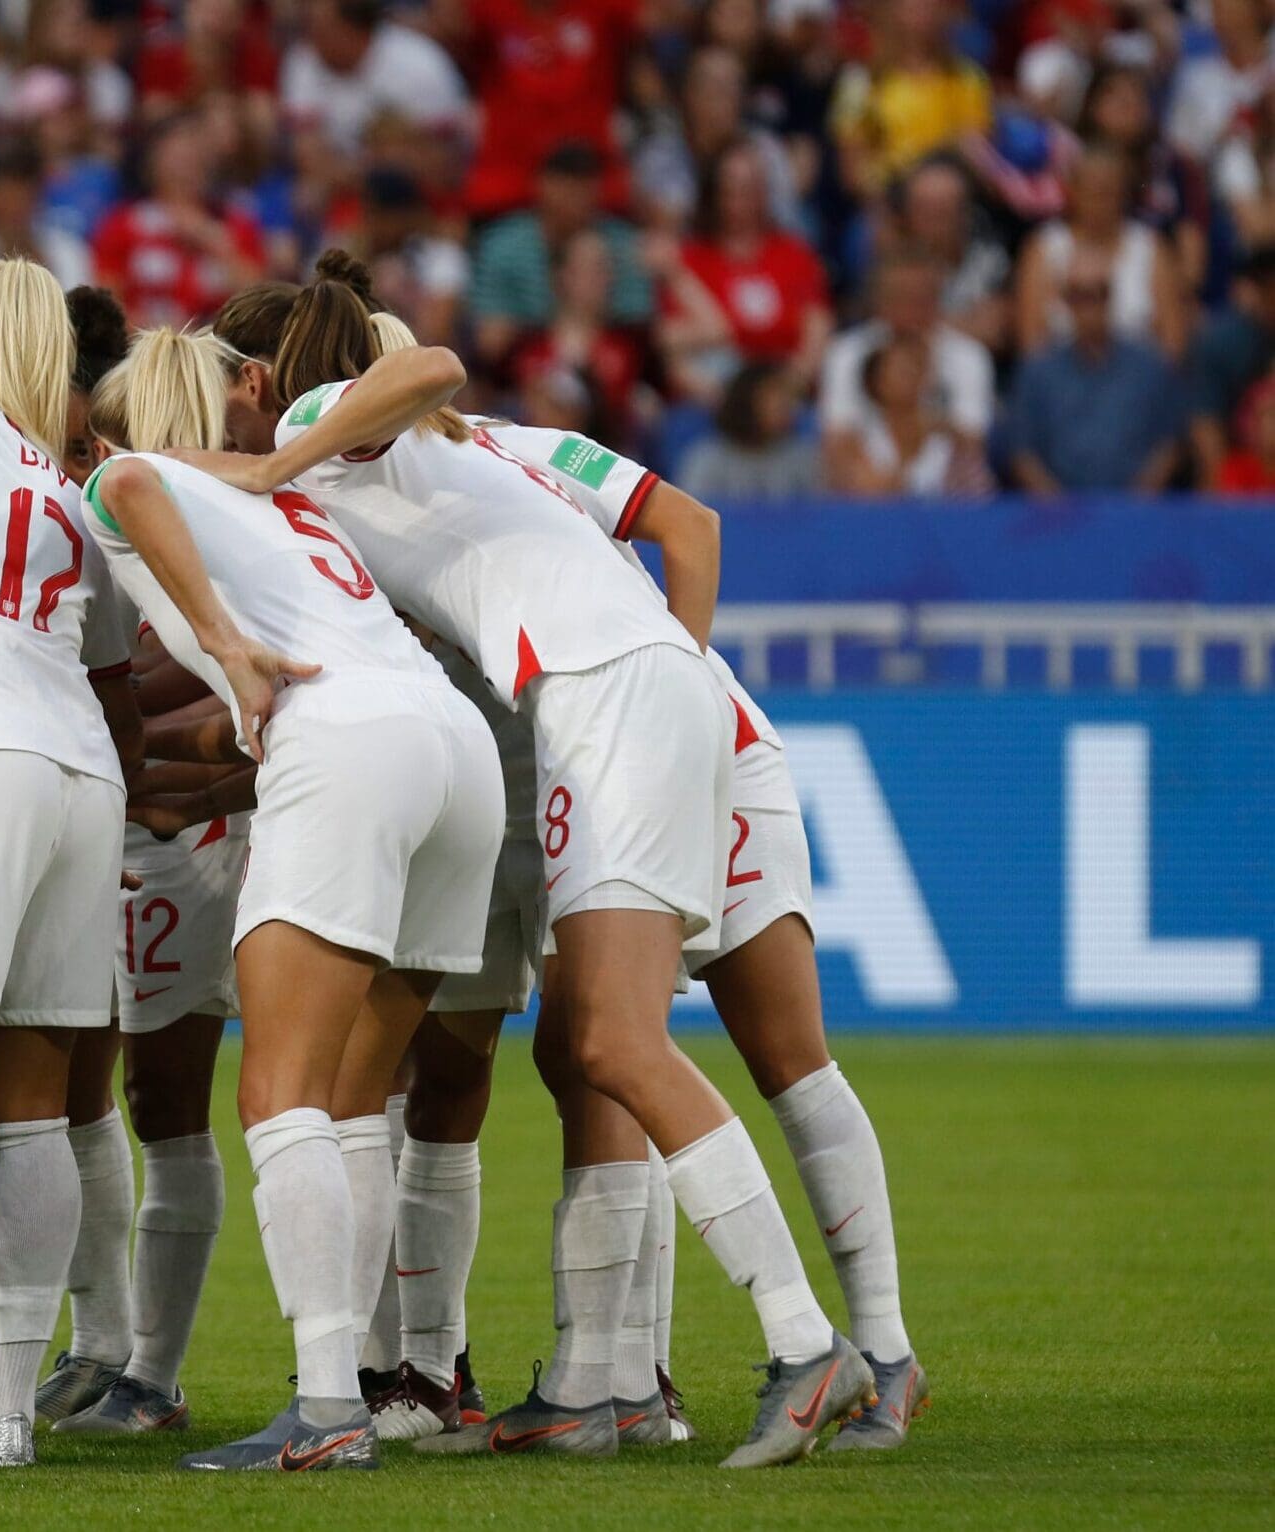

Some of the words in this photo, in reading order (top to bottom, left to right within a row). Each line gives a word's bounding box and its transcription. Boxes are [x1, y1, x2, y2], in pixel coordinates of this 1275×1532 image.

[272, 490, 376, 600] 5
[545, 785, 572, 859] 8
[726, 811, 763, 888] 2
[125, 897, 181, 974] 12
